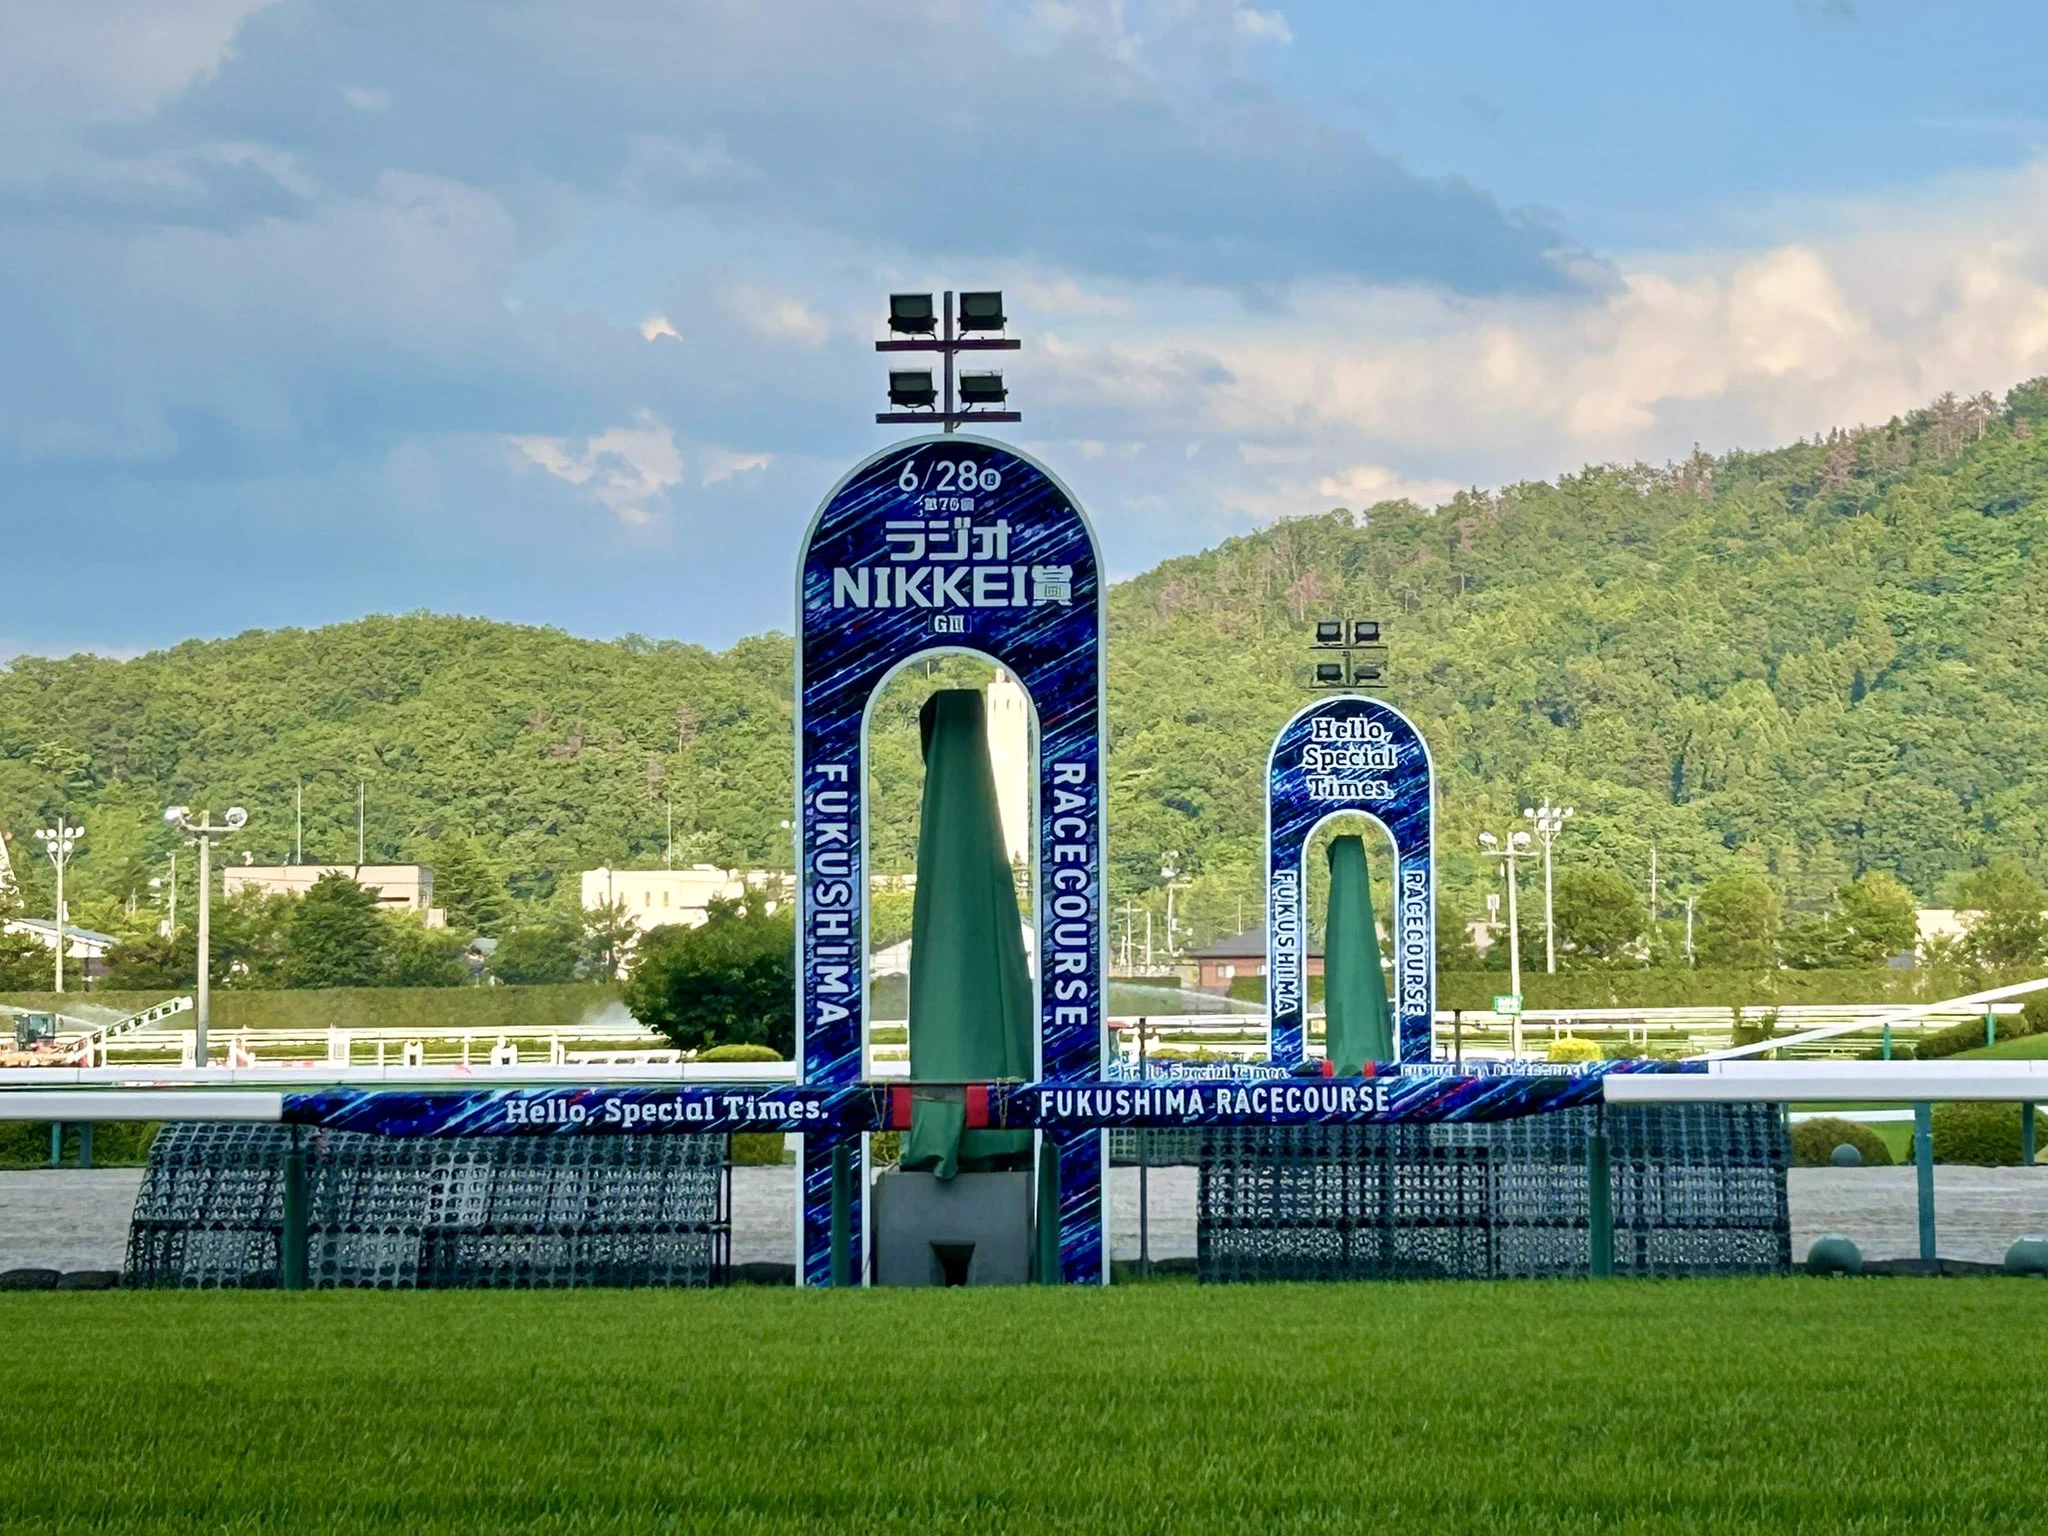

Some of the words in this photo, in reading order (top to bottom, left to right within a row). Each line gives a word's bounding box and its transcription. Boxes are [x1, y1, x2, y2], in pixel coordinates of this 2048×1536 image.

[885, 517, 1012, 561] ラジオ
[1312, 718, 1392, 743] Hello,
[1304, 745, 1397, 772] Special
[1307, 775, 1395, 799] Times.
[815, 764, 849, 1026] FUKUSHIMA
[1053, 763, 1089, 1026] RACECOURSE
[1274, 870, 1297, 1018] FUKUSHIMA
[1405, 870, 1426, 1016] RACECOURSE
[505, 1099, 594, 1125] Hello,
[604, 1097, 715, 1128] Special
[723, 1095, 829, 1122] Times.
[1040, 1089, 1205, 1117] FUKUSHIMA
[1216, 1086, 1390, 1114] RACECOURSE
